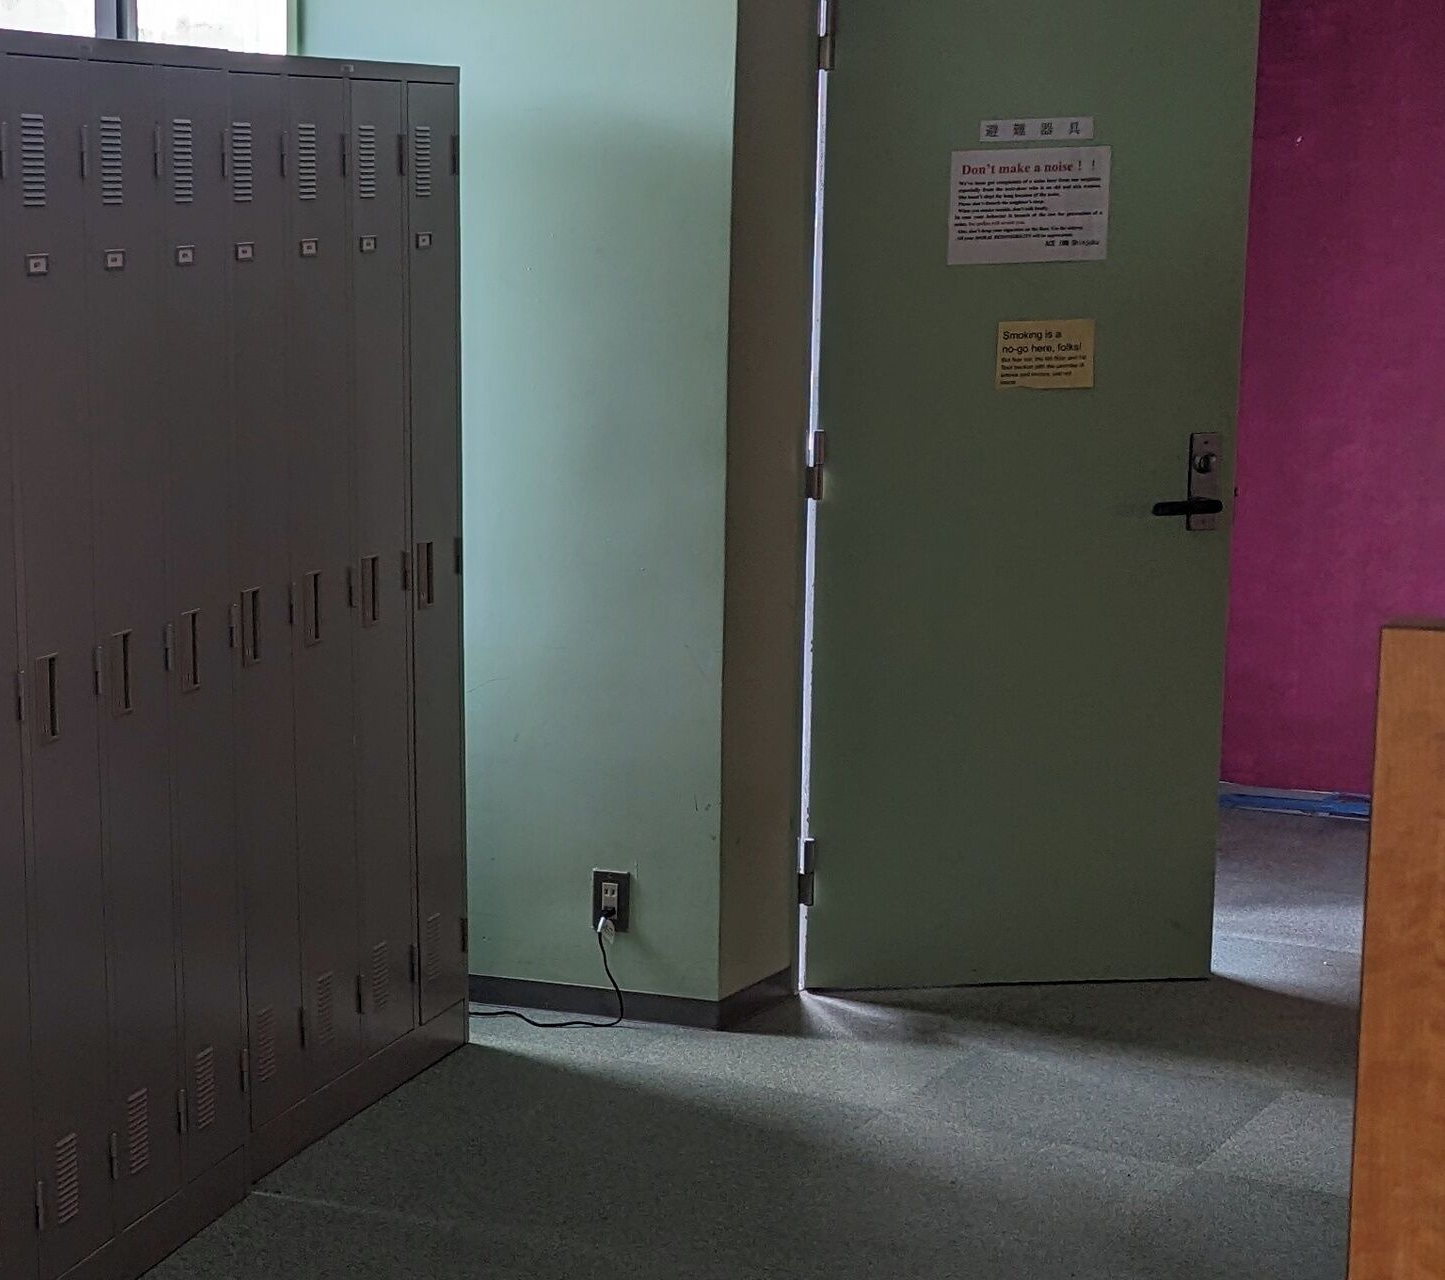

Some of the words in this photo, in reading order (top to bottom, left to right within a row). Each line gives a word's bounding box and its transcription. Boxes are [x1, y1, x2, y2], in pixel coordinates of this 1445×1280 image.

[962, 163, 996, 175] Don't
[999, 163, 1031, 174] make
[1033, 164, 1041, 173] a
[1044, 161, 1073, 173] noise
[1002, 331, 1043, 341] Smoking
[1045, 330, 1053, 339] is
[1002, 345, 1029, 355] no-go
